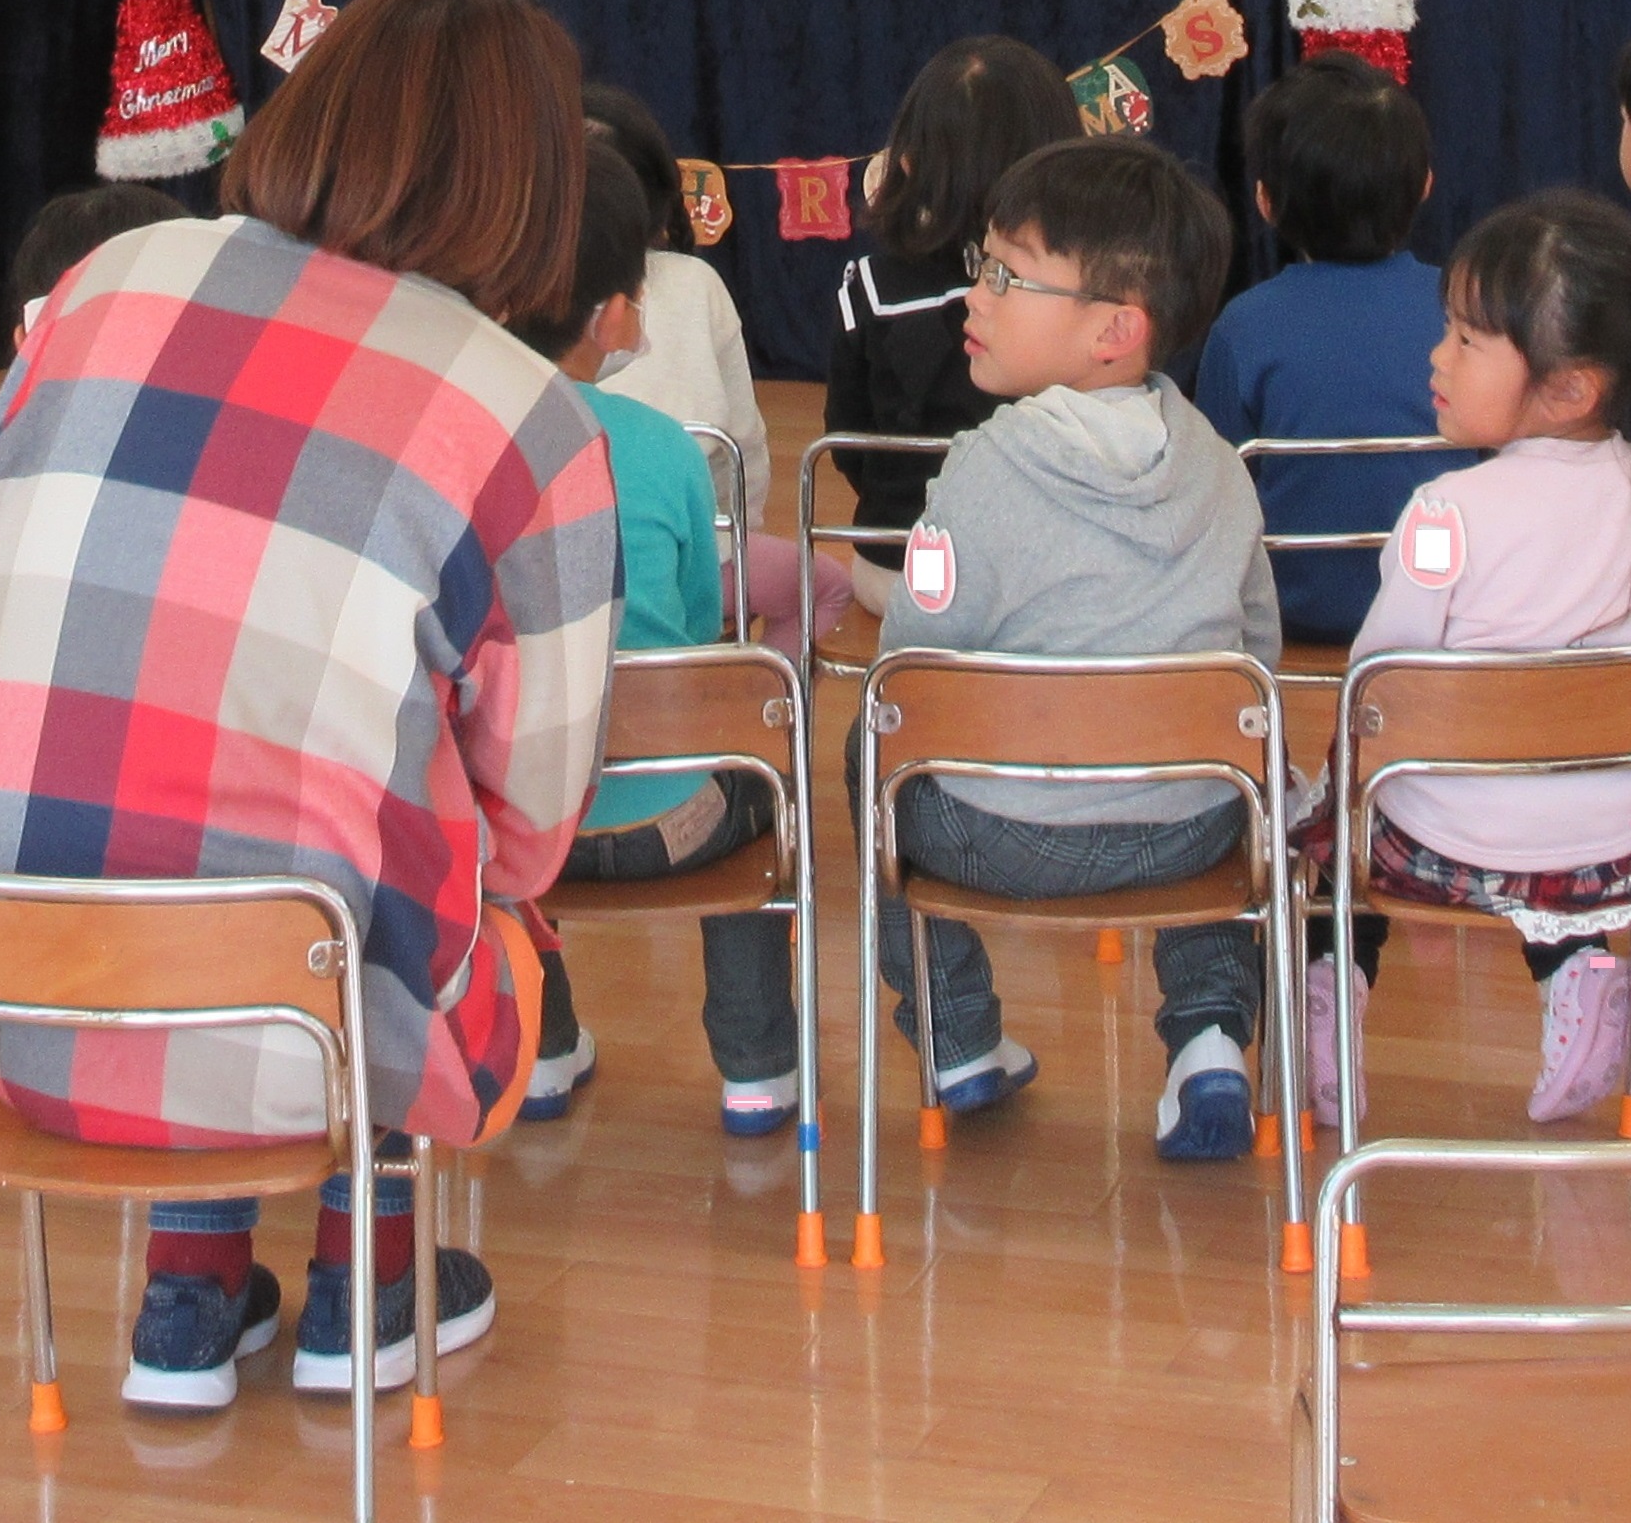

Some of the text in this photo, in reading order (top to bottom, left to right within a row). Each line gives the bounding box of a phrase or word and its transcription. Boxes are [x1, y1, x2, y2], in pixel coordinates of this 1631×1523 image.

[133, 31, 189, 73] Merry
[1185, 10, 1224, 63] S
[119, 76, 216, 120] Christmas
[798, 177, 832, 223] R
